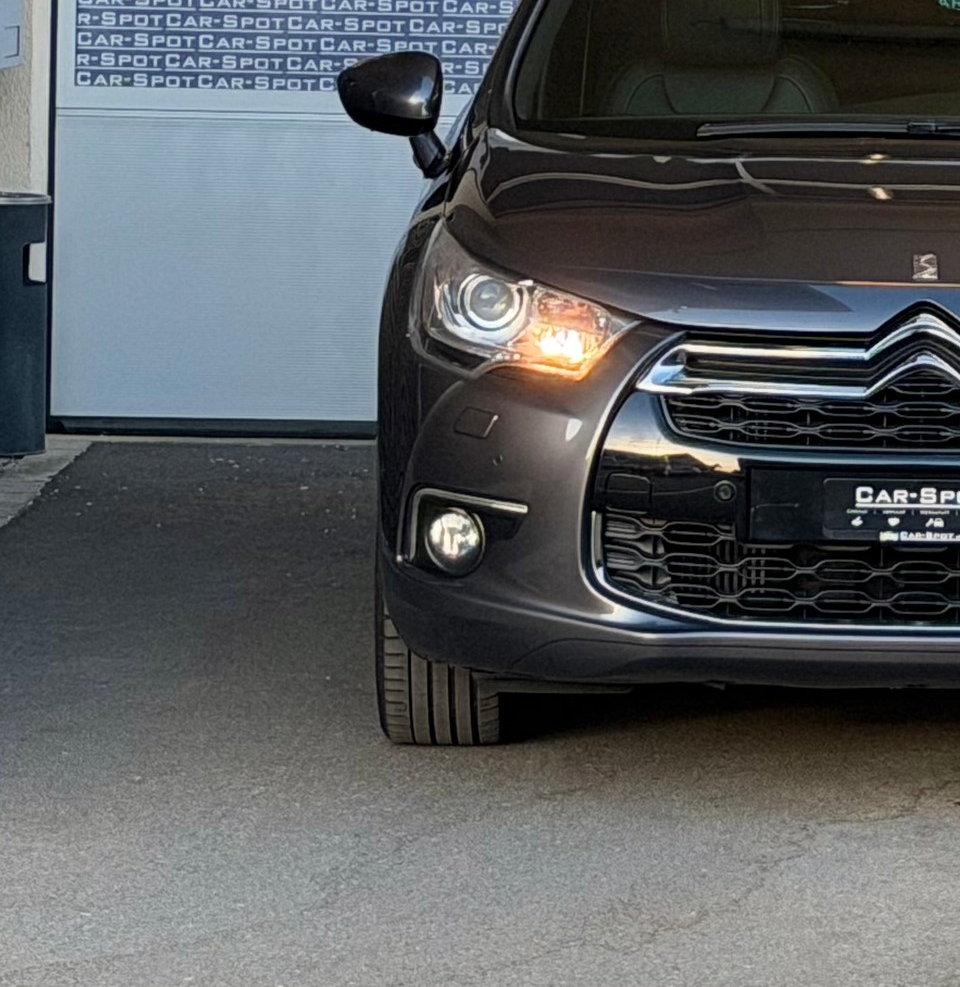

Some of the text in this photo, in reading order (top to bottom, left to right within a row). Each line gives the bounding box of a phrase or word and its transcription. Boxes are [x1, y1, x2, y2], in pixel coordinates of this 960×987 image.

[166, 12, 405, 32] CAR-SPOT CAR-SPOT
[77, 31, 195, 48] CAR-SPOT
[198, 34, 316, 51] CAR-SPOT
[165, 53, 283, 70] CAR-SPOT
[76, 71, 315, 91] CAR-SPOT CAR-SPOT
